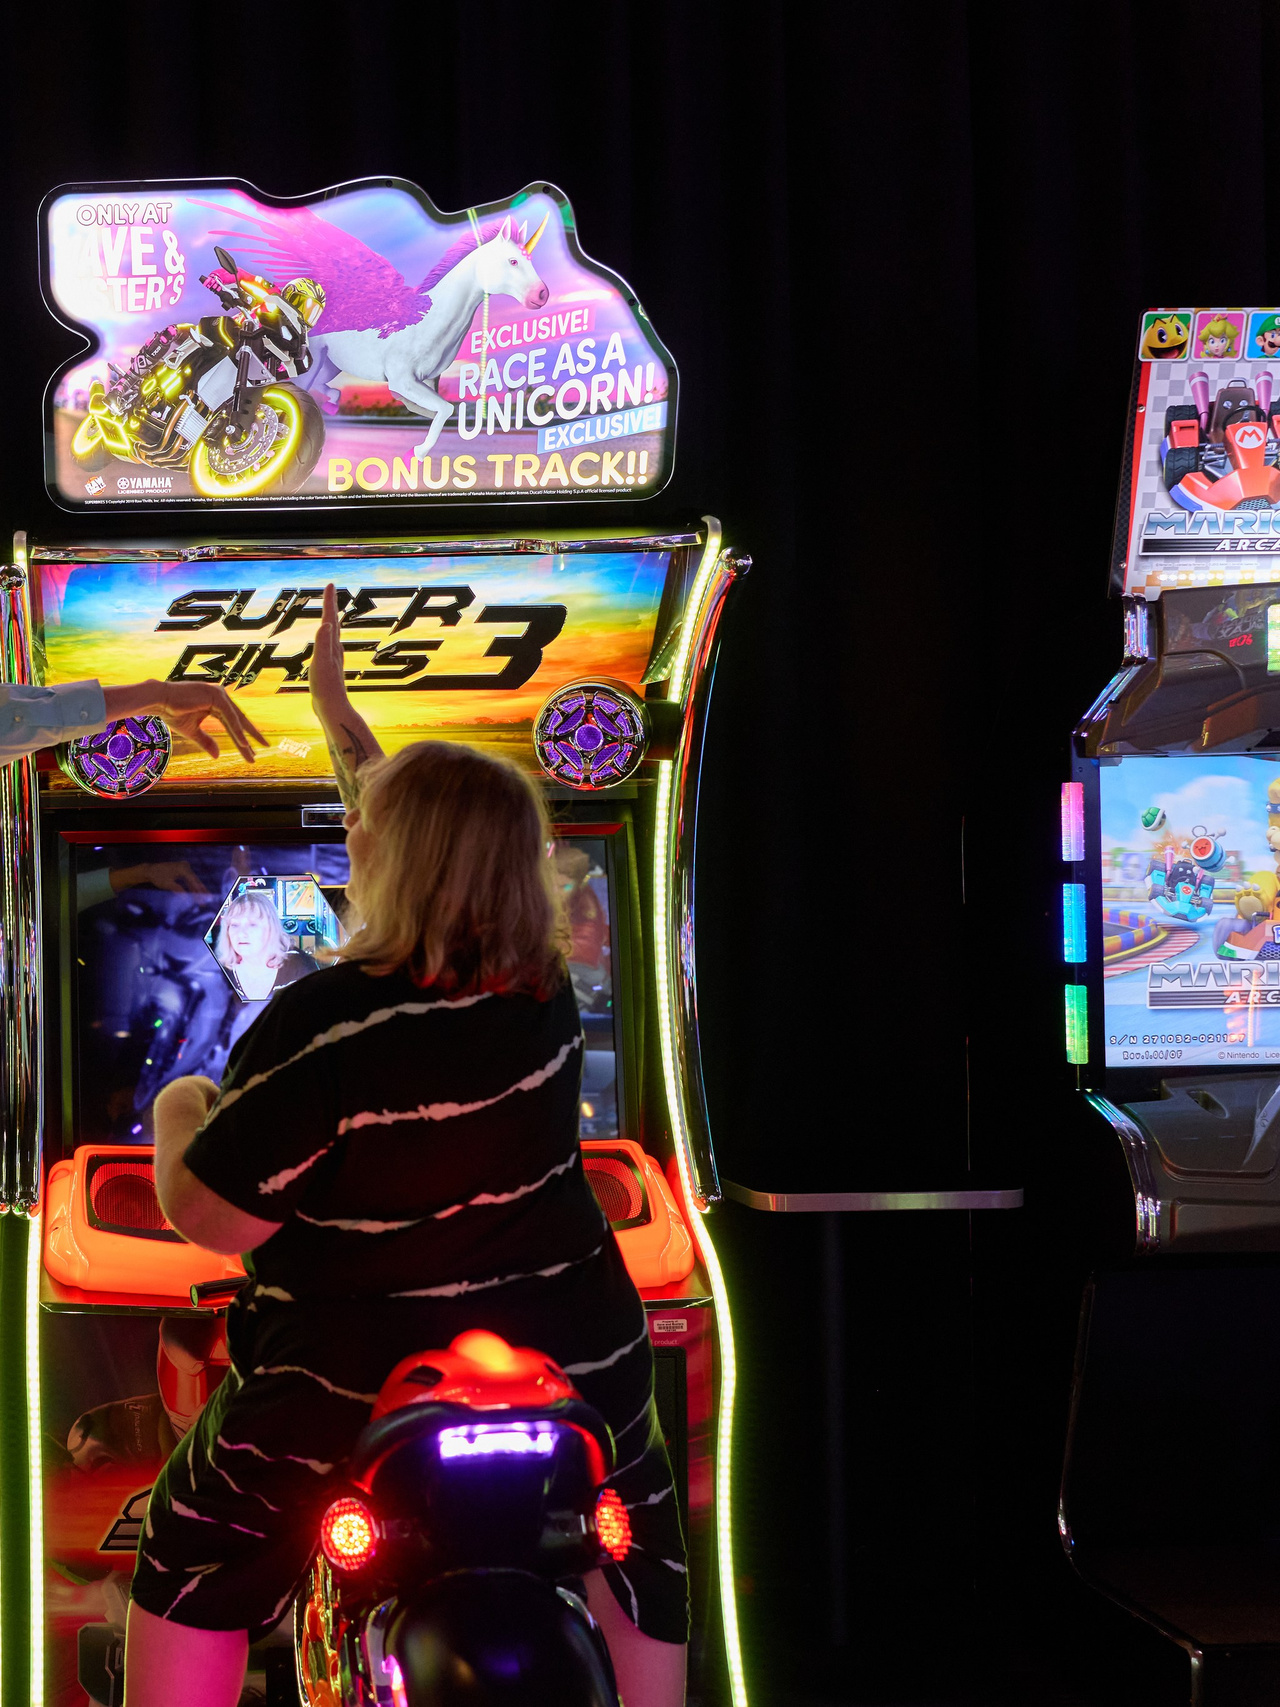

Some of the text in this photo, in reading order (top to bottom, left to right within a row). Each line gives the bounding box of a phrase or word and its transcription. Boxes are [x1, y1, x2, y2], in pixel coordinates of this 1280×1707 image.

[76, 202, 173, 226] ONLY AT
[162, 229, 186, 275] &
[471, 308, 590, 354] EXCLUSIVE!
[458, 331, 627, 400] RACE AS A
[457, 362, 656, 441] UNICORN!
[543, 405, 662, 451] EXCLUSIVE!
[129, 477, 172, 488] YAMAHA
[327, 450, 649, 492] BONUS TRACK!!
[1143, 511, 1280, 536] MARI
[154, 584, 477, 637] SUPER
[1109, 1034, 1138, 1045] S/N
[1226, 1052, 1260, 1060] Nintendo
